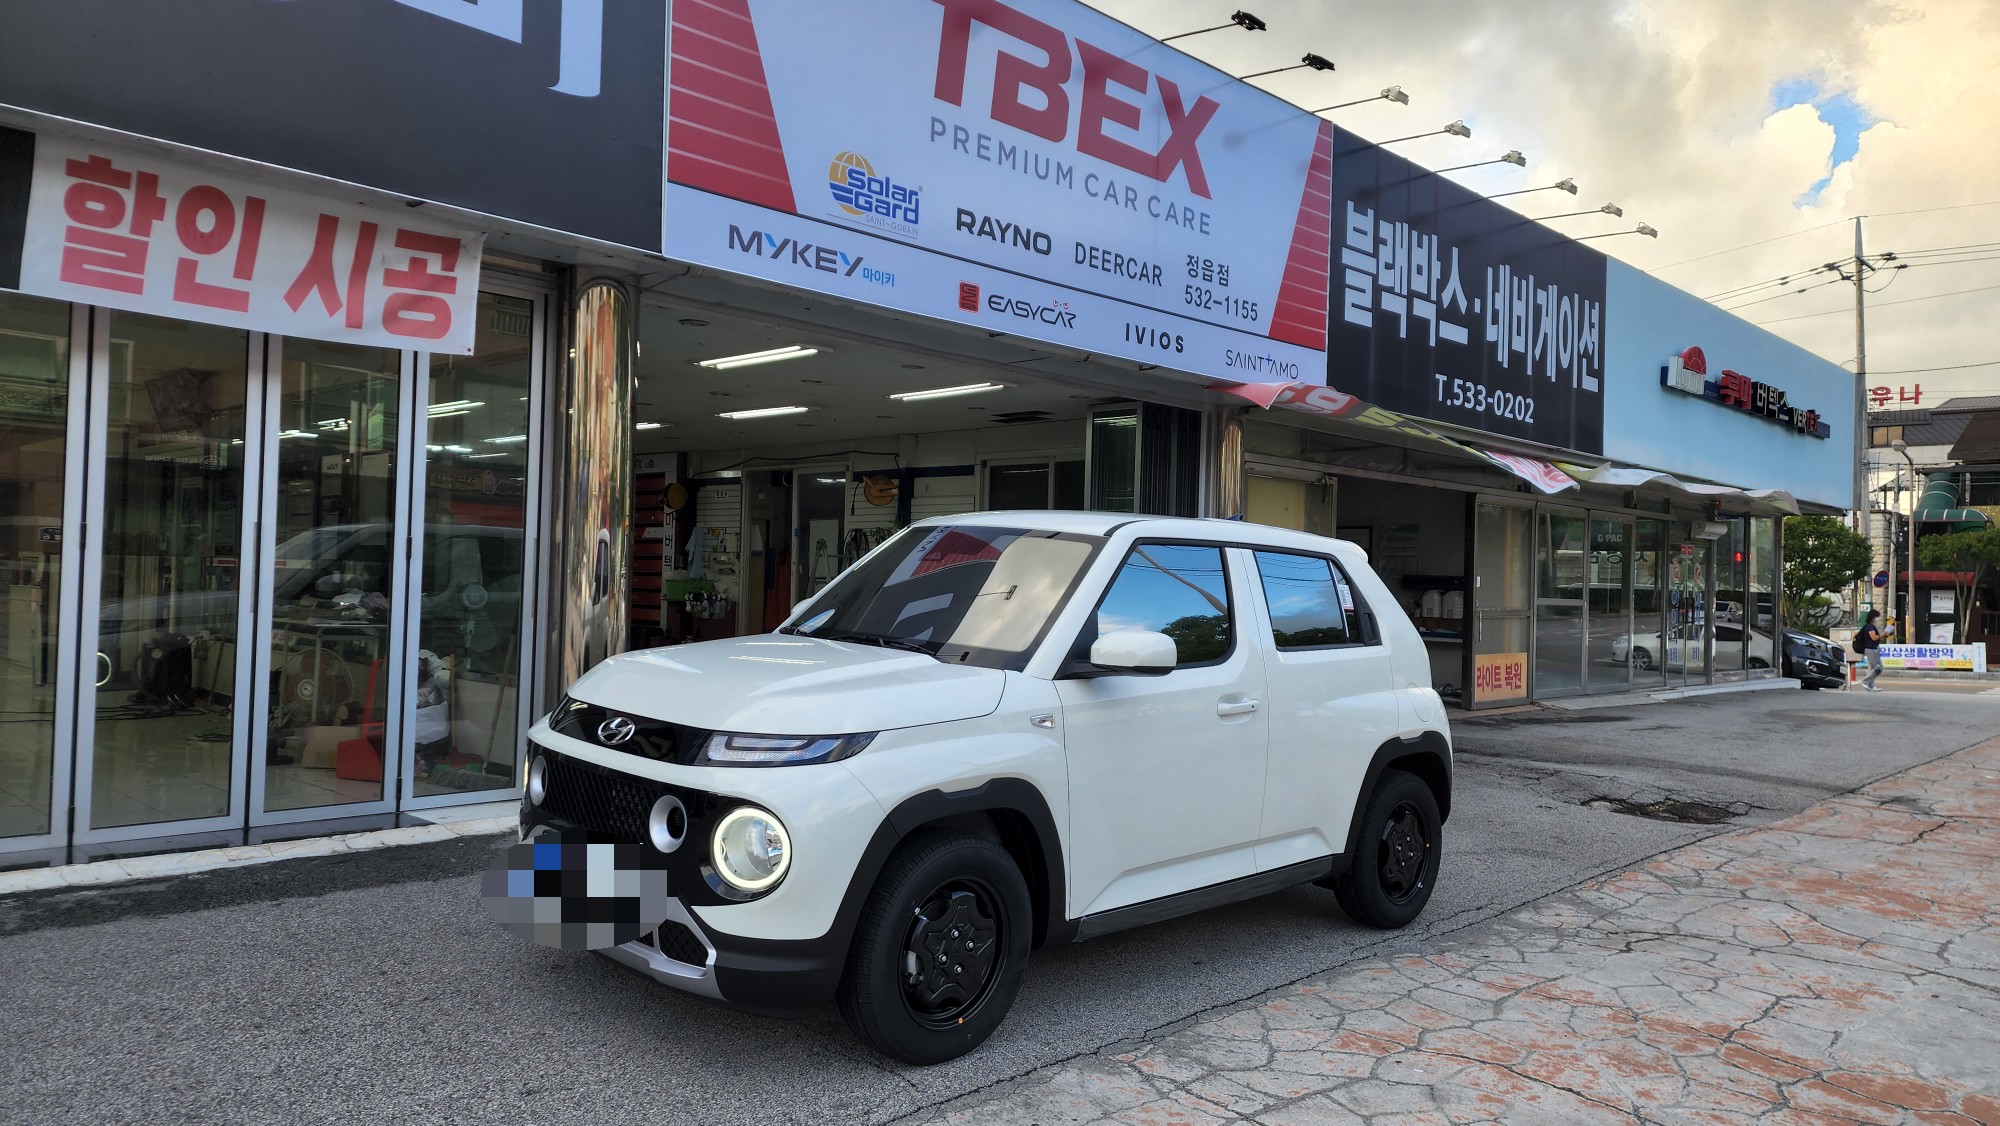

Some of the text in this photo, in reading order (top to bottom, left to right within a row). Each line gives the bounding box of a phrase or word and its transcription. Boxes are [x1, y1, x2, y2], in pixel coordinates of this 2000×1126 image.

[931, 0, 1220, 200] TBEX
[847, 168, 919, 205] Solar
[930, 116, 1210, 235] PREMIUM CAR CARE
[854, 190, 919, 225] Gard
[866, 214, 919, 236] SAINT-GOBAIN
[59, 153, 462, 339] 할인 시공
[956, 207, 1052, 256] RAYNO
[729, 224, 895, 287] MYKEY 마이키
[1075, 241, 1163, 287] DEERCAR
[1186, 254, 1229, 287] 정읍점
[988, 294, 1077, 329] EASYCAR
[1184, 284, 1258, 322] 532-1155
[1125, 322, 1184, 354] IVIOS
[1720, 370, 1819, 434] 루마 버텍스 VERTEX
[1871, 384, 1923, 407] 우나
[1476, 662, 1522, 693] 라이트 복원
